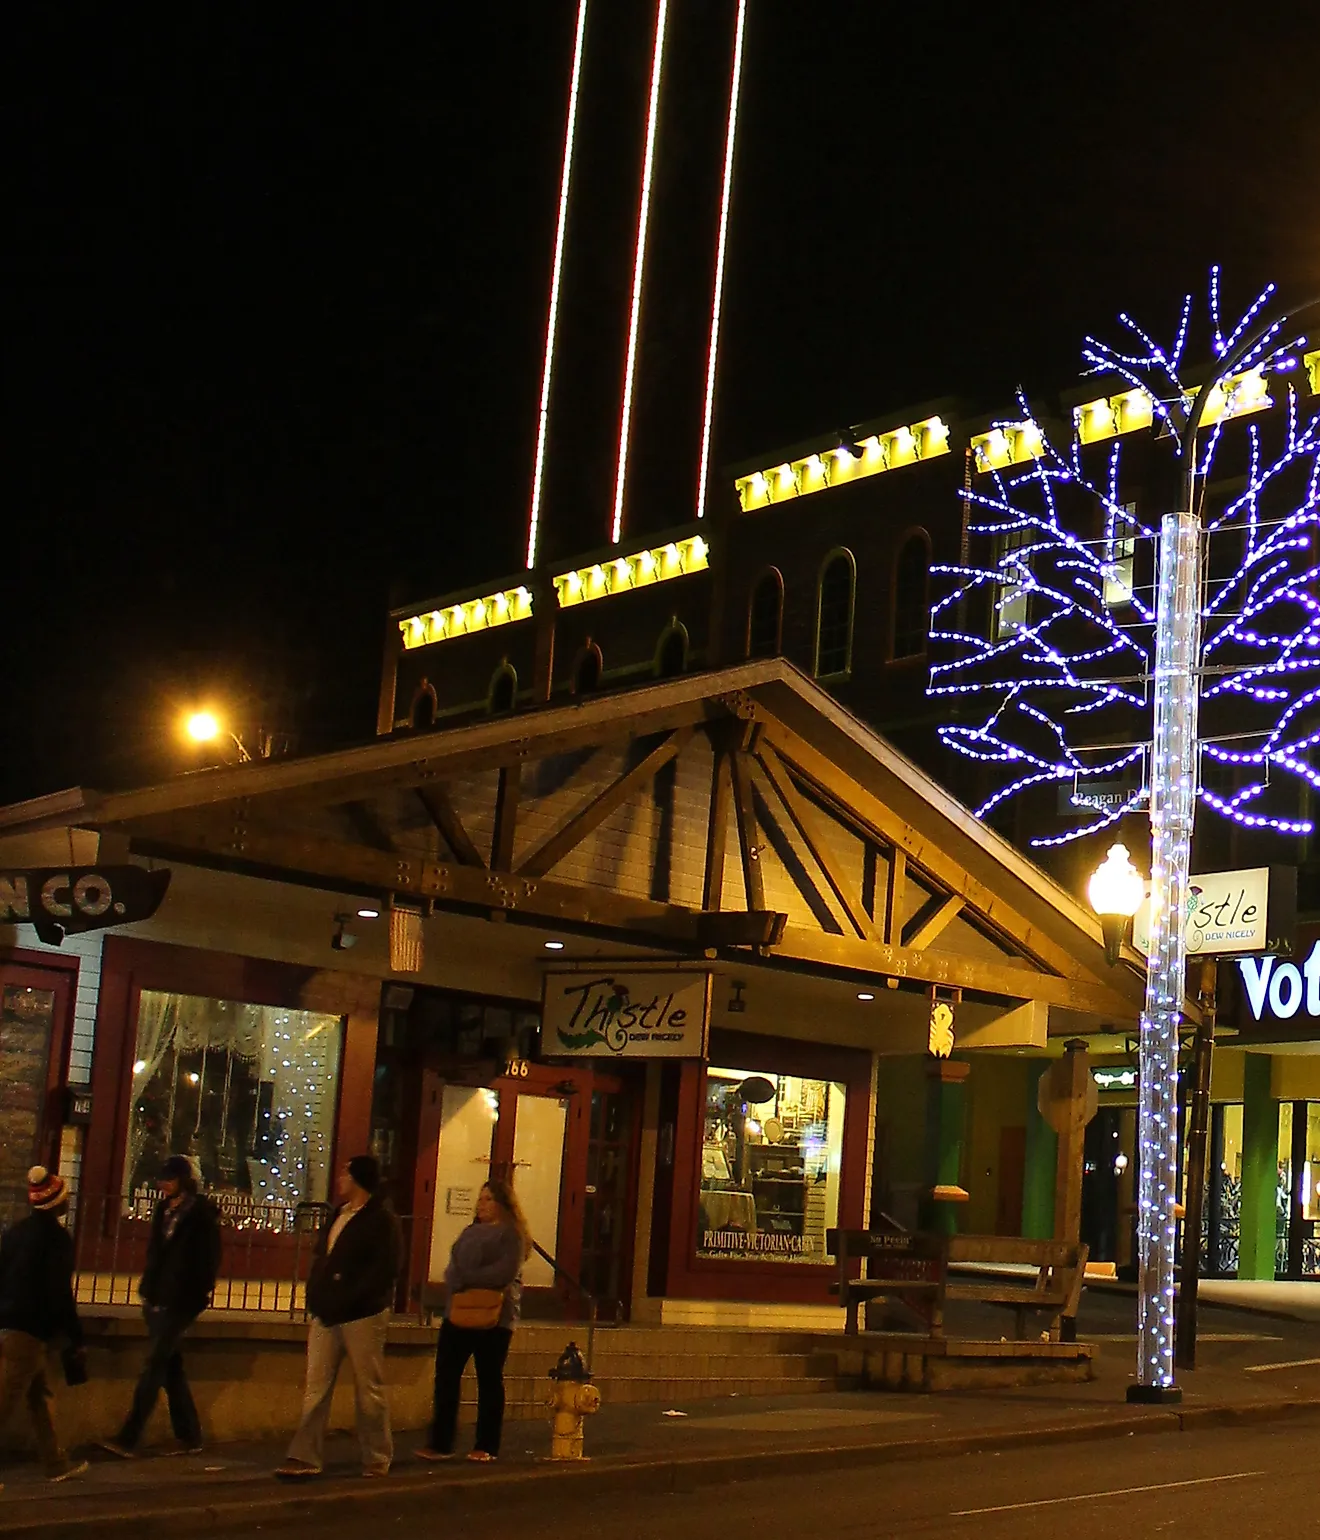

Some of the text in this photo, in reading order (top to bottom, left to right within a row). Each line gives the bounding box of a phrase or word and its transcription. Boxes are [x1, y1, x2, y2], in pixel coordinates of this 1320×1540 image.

[41, 873, 127, 917] CO.
[1205, 929, 1257, 941] DEW NICELY
[564, 978, 687, 1031] Thistle
